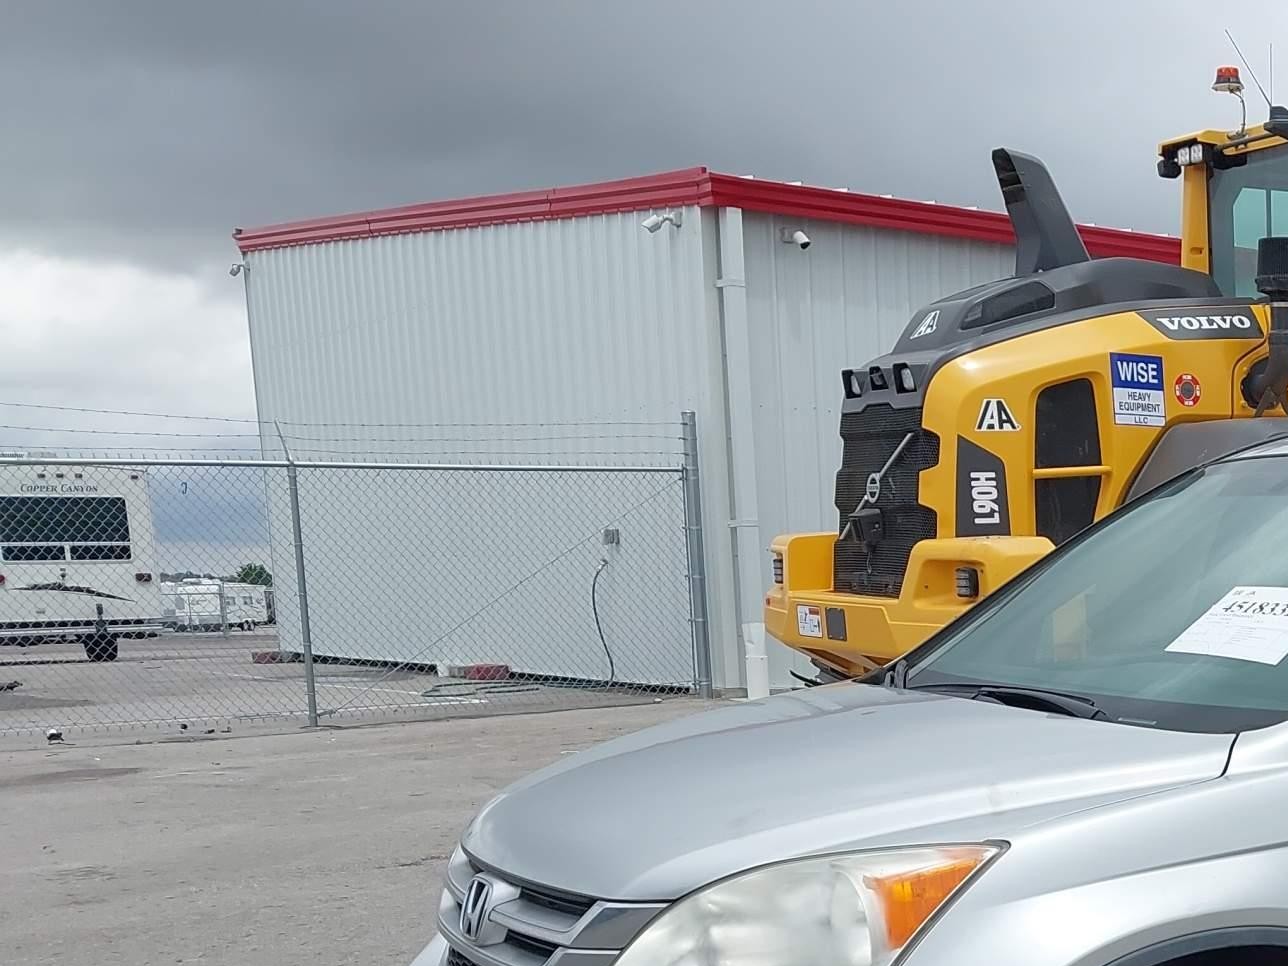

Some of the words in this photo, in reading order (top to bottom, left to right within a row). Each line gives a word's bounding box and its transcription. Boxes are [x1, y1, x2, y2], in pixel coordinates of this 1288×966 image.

[1157, 315, 1251, 331] VOLVO
[1117, 360, 1159, 384] WISE
[1127, 391, 1151, 402] HEAVY
[1118, 401, 1160, 414] EQUIPMENT
[1133, 416, 1149, 425] LLC
[20, 483, 57, 493] COPPER
[60, 483, 98, 493] CANYON
[970, 471, 1001, 524] L90H
